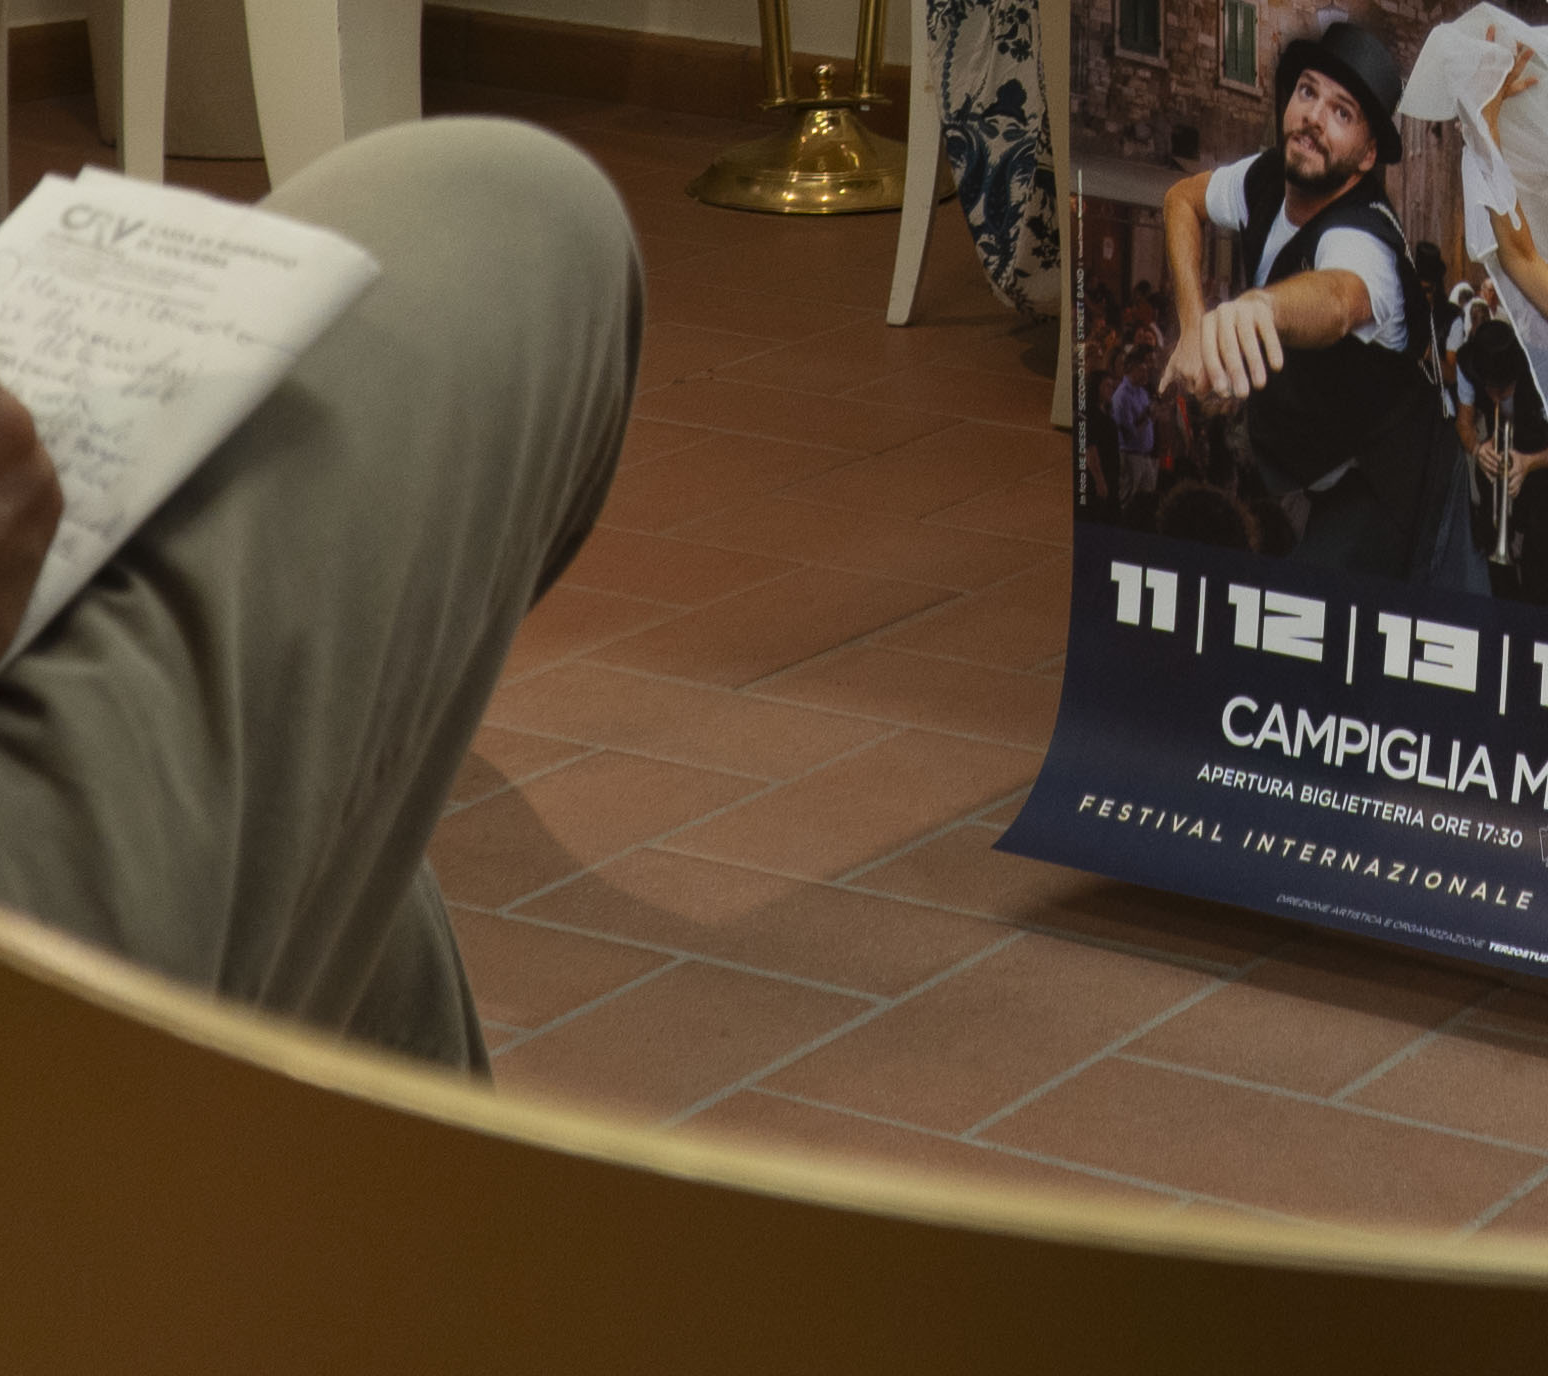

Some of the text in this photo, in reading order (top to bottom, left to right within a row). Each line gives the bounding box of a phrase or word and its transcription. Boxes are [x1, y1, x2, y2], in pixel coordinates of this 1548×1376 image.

[1076, 268, 1085, 298] BAND
[1076, 301, 1086, 341] STREET
[1077, 367, 1087, 411] SECOND
[1110, 560, 1178, 633] 11
[1228, 583, 1326, 662] 12
[1378, 611, 1479, 692] 13
[1222, 696, 1498, 800] CAMPIGLIA
[1197, 763, 1523, 848] APERTURA BIGLIETTERIA ORE 17:30
[1079, 794, 1223, 842] FESTIVAL
[1243, 830, 1533, 910] INTERNAZIONALE
[1331, 905, 1382, 927] ARTISTICA
